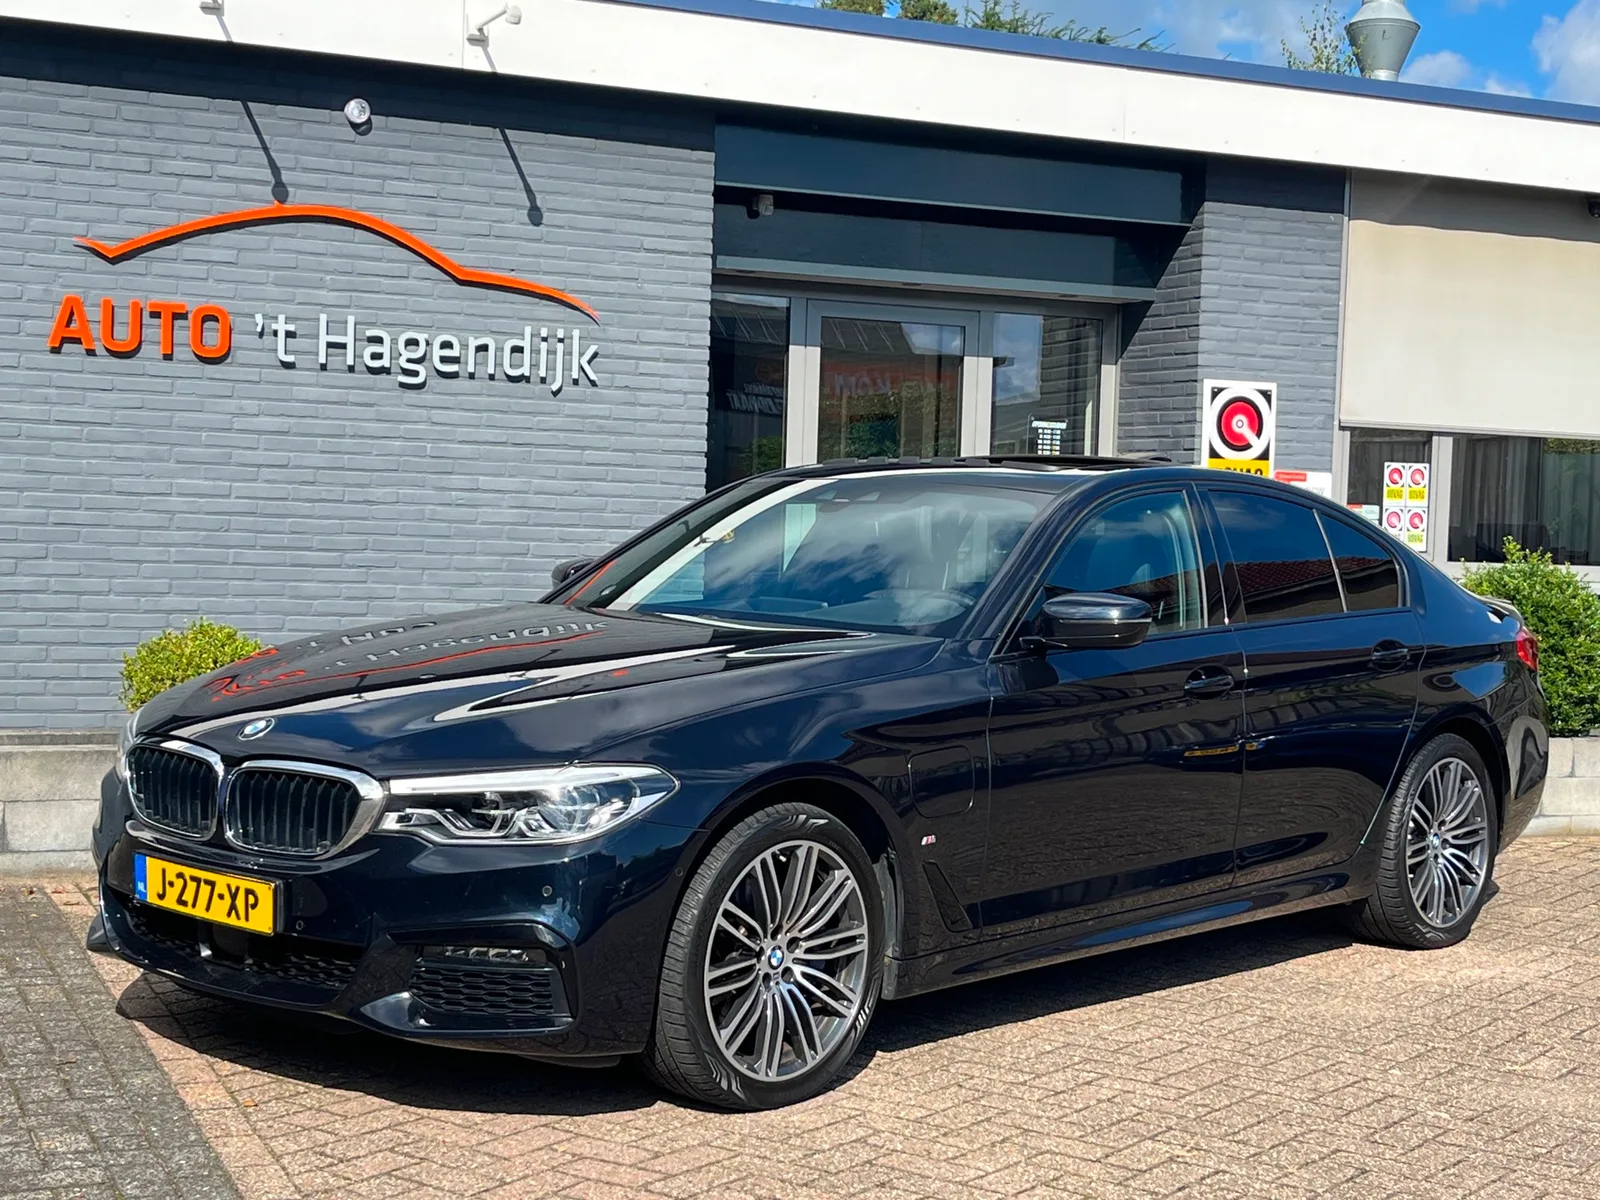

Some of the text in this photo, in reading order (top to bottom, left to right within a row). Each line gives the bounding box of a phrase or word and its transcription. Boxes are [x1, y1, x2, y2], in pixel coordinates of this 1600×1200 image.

[47, 294, 232, 359] AUTO
[318, 313, 599, 393] Hagendijk
[156, 867, 259, 923] J-277-XP
